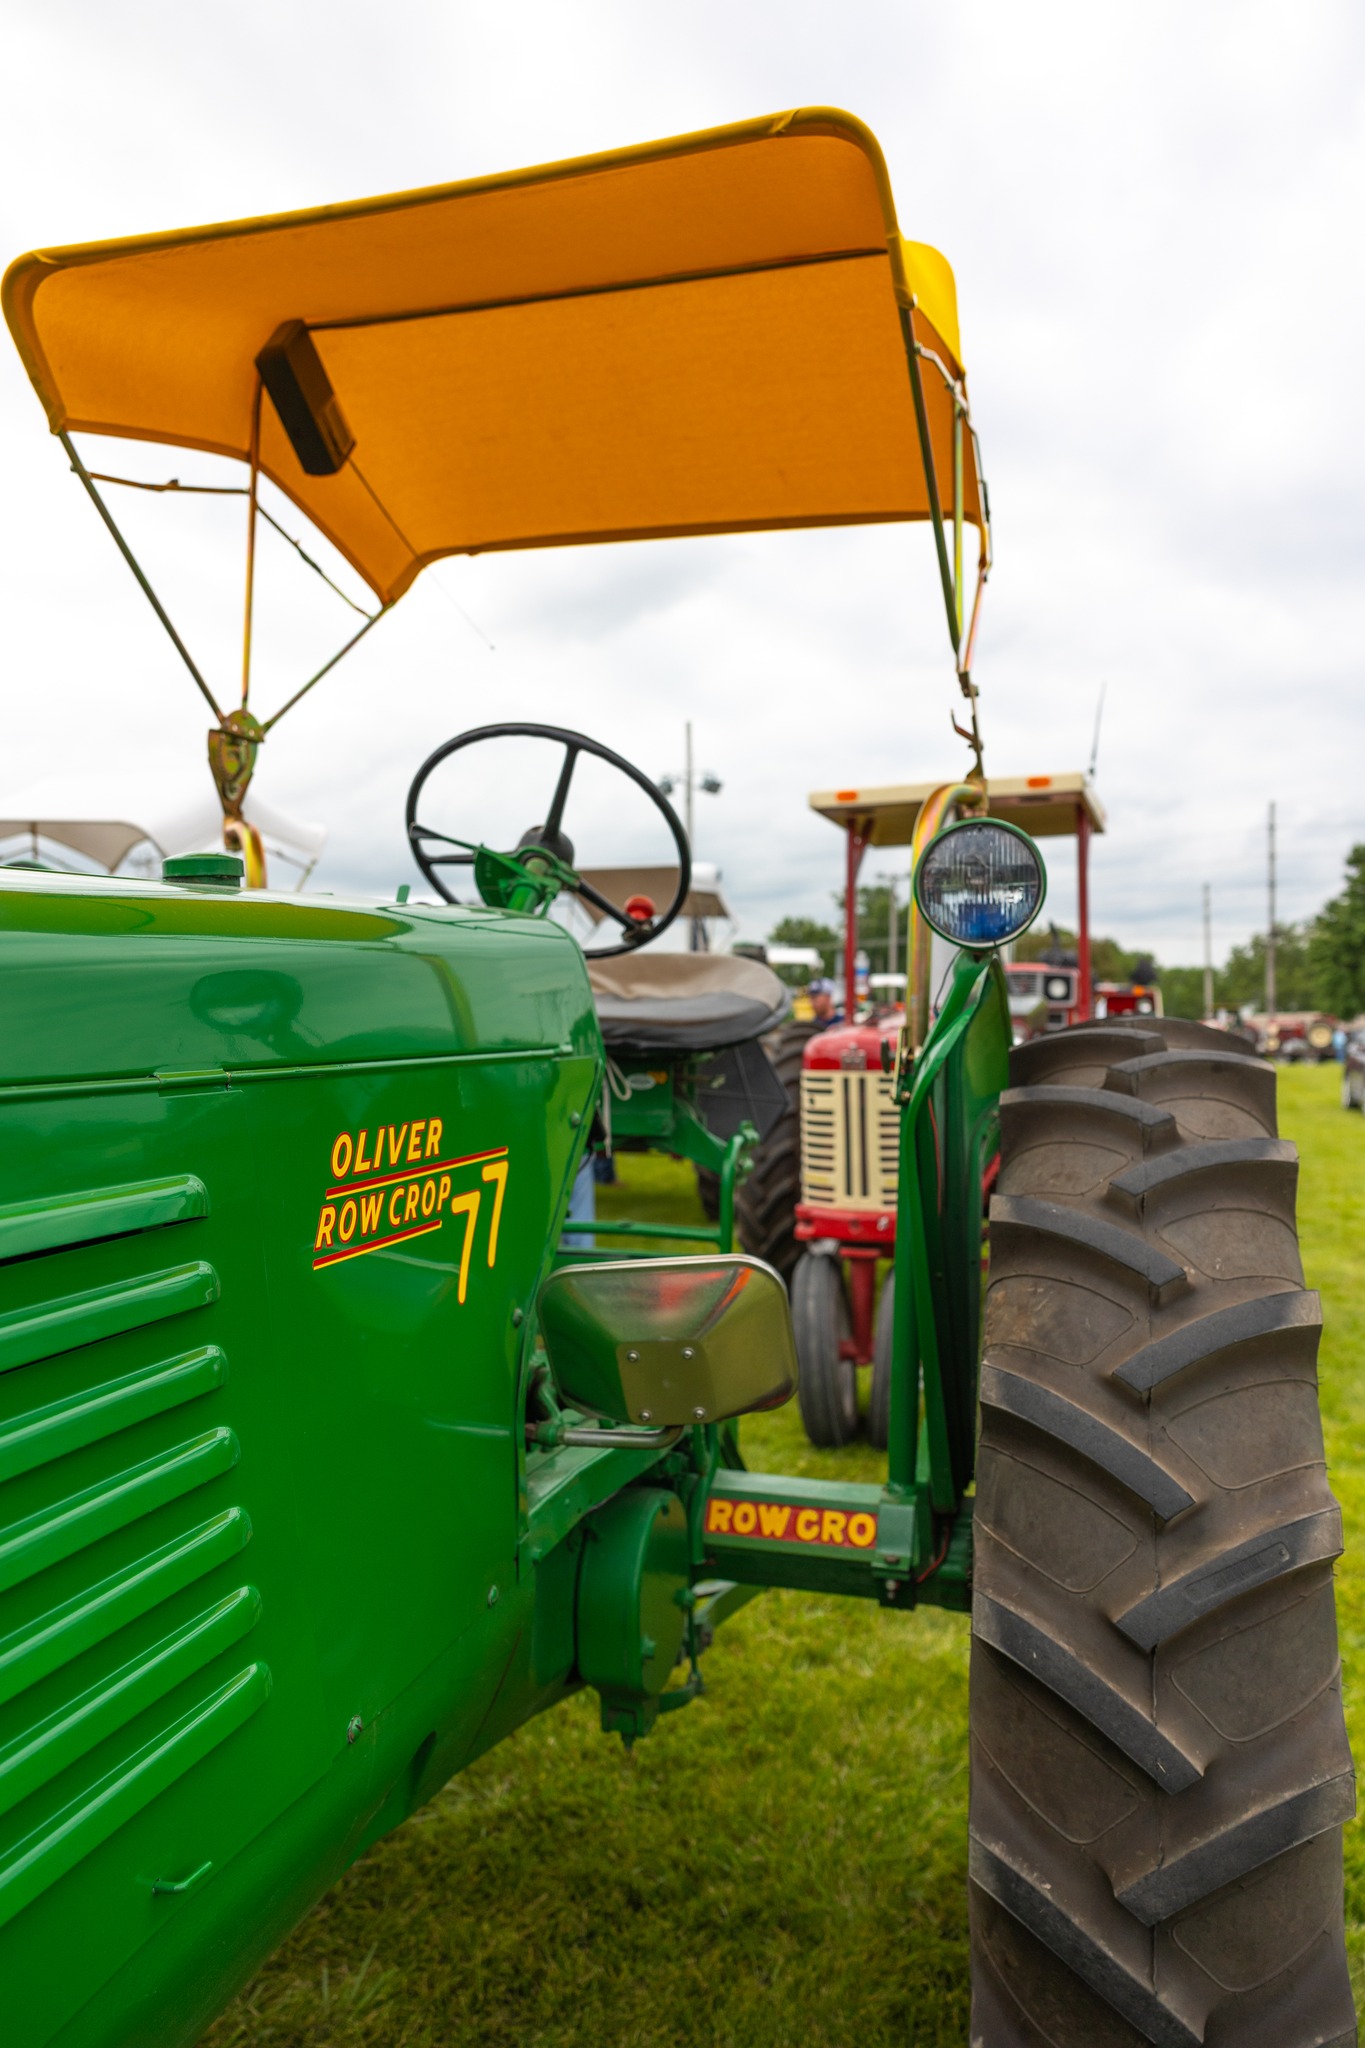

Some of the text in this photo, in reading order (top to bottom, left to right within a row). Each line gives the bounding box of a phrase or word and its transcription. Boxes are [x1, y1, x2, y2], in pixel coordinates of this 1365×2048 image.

[331, 1117, 443, 1180] OLIVER
[314, 1174, 451, 1252] ROW CROP
[451, 1159, 509, 1305] 77
[707, 1499, 792, 1539] ROW
